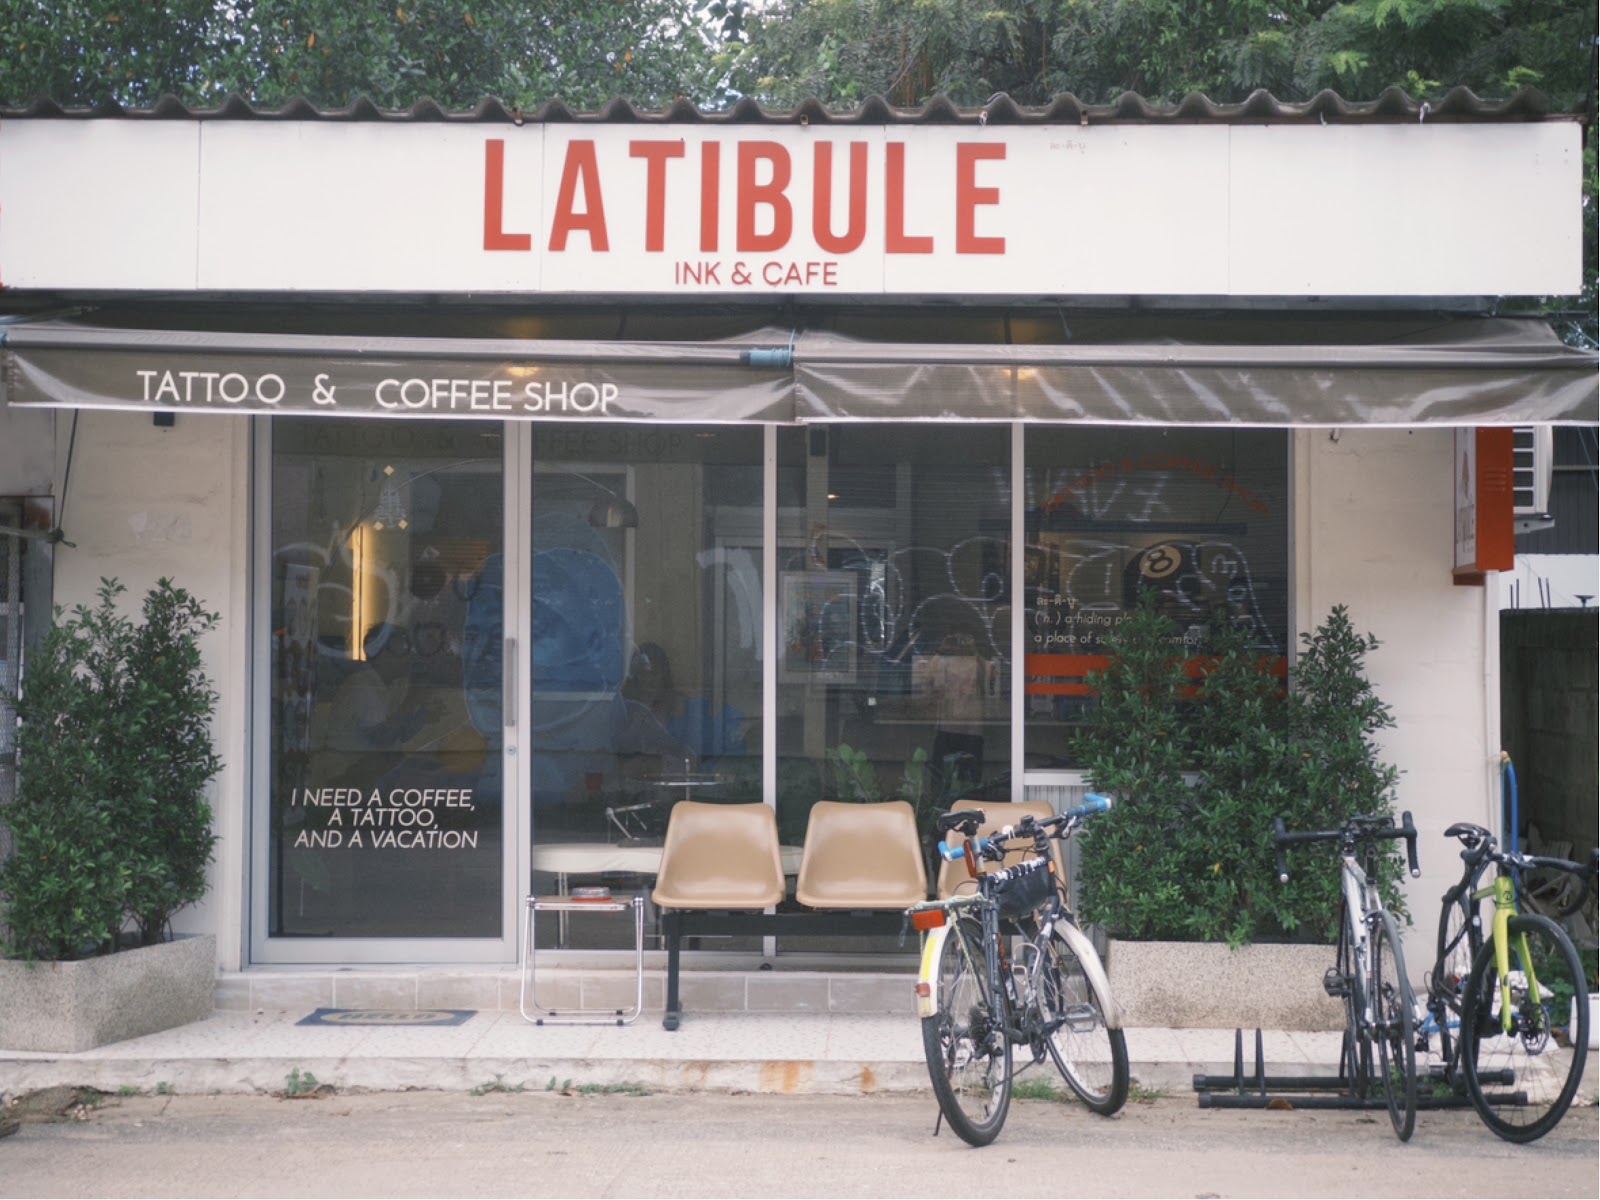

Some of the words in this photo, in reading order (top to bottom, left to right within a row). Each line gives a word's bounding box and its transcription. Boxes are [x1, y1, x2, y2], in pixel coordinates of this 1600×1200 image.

[483, 139, 1007, 255] LATIBULE
[674, 262, 721, 285] INK
[731, 262, 753, 285] &
[763, 263, 838, 286] CAFE
[136, 370, 286, 405] TATTOO
[312, 373, 337, 405] &
[375, 378, 513, 411] COFFEE
[523, 381, 620, 413] SHOP
[1076, 611, 1111, 626] hiding
[1034, 634, 1043, 643] a
[1046, 631, 1077, 648] place
[1080, 631, 1093, 644] of
[291, 788, 297, 807] I
[302, 788, 363, 807] NEED
[366, 788, 383, 806] A
[389, 788, 475, 812] COFFEE,
[327, 808, 343, 826] A
[350, 808, 439, 829] TATTOO,
[293, 829, 343, 848] AND
[347, 830, 364, 848] A
[370, 830, 479, 849] VACATION
